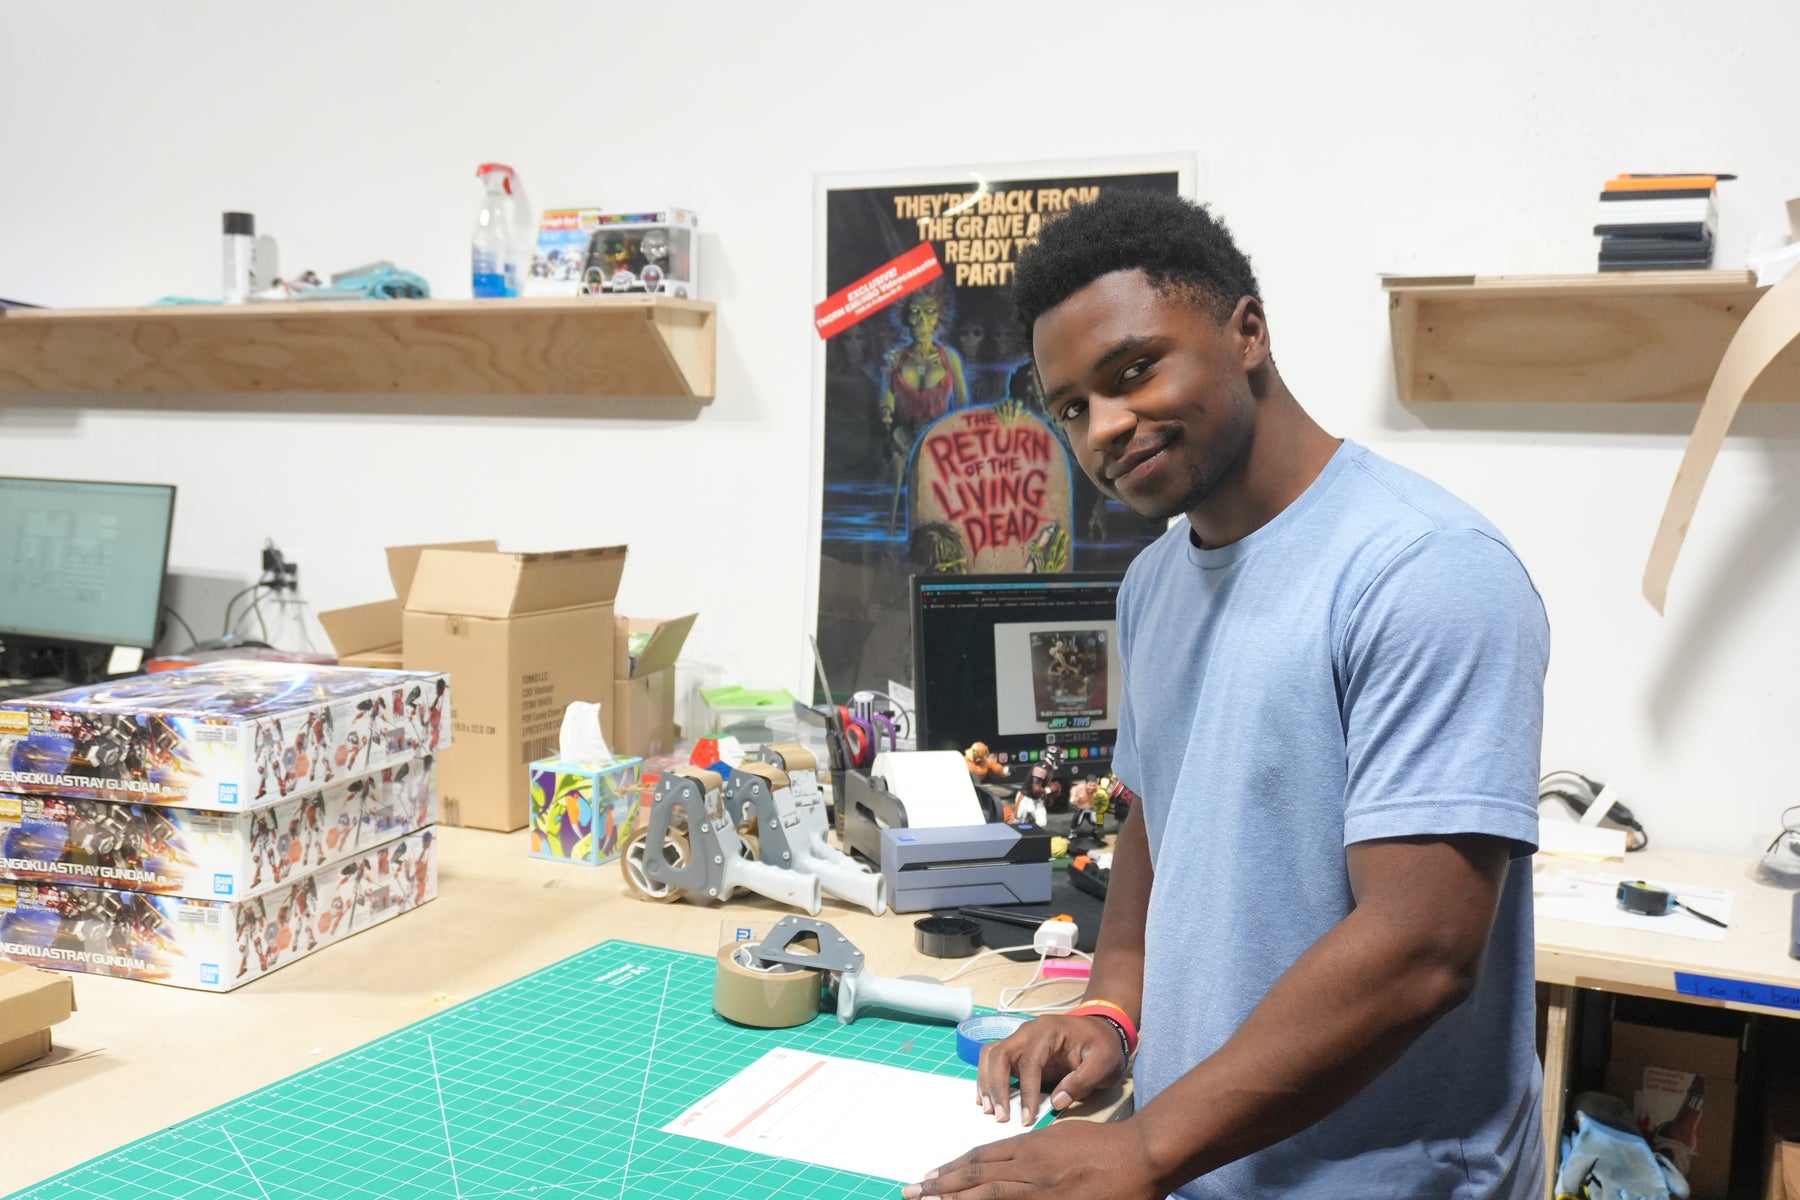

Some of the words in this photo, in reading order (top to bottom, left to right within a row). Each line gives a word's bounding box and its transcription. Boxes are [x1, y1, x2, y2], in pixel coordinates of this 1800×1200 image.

[978, 189, 1033, 215] BACK
[1037, 186, 1100, 213] FROM
[916, 216, 953, 241] THE
[955, 213, 1024, 239] GRAVE
[945, 238, 1012, 264] READY
[1014, 238, 1039, 257] T
[961, 411, 997, 428] THE
[926, 426, 1051, 484] RETURN
[964, 460, 985, 477] OF
[987, 456, 1020, 474] THE
[931, 469, 1047, 521] LIVING
[963, 508, 1042, 558] DEAD
[486, 725, 496, 736] CM
[55, 774, 105, 789] ASTRAY
[106, 779, 160, 794] GUNDAM
[48, 861, 100, 877] ASTRAY
[101, 866, 155, 883] GUNDAM
[42, 947, 91, 963] ASTRAY
[92, 953, 145, 970] GUNDAM
